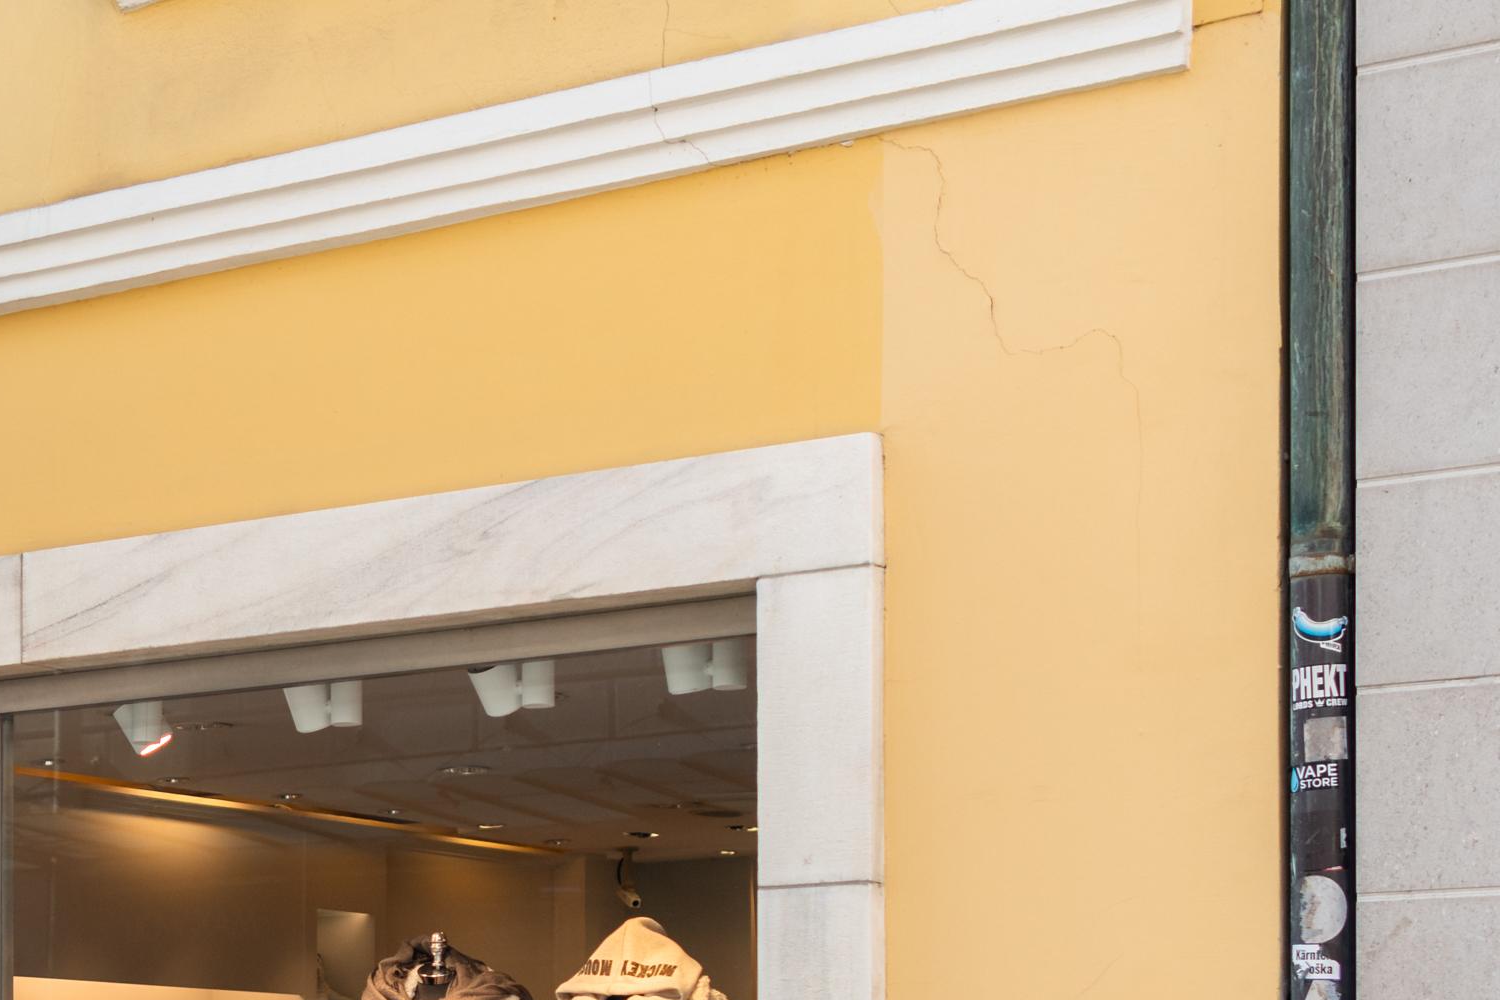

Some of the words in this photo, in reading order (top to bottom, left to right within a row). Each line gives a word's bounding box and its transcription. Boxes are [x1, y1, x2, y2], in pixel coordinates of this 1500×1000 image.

[1291, 663, 1347, 702] PHEKT
[1296, 763, 1339, 780] VAPE
[1299, 777, 1339, 790] STORE
[1295, 949, 1329, 960] Kärnte
[620, 959, 678, 979] MICKEY
